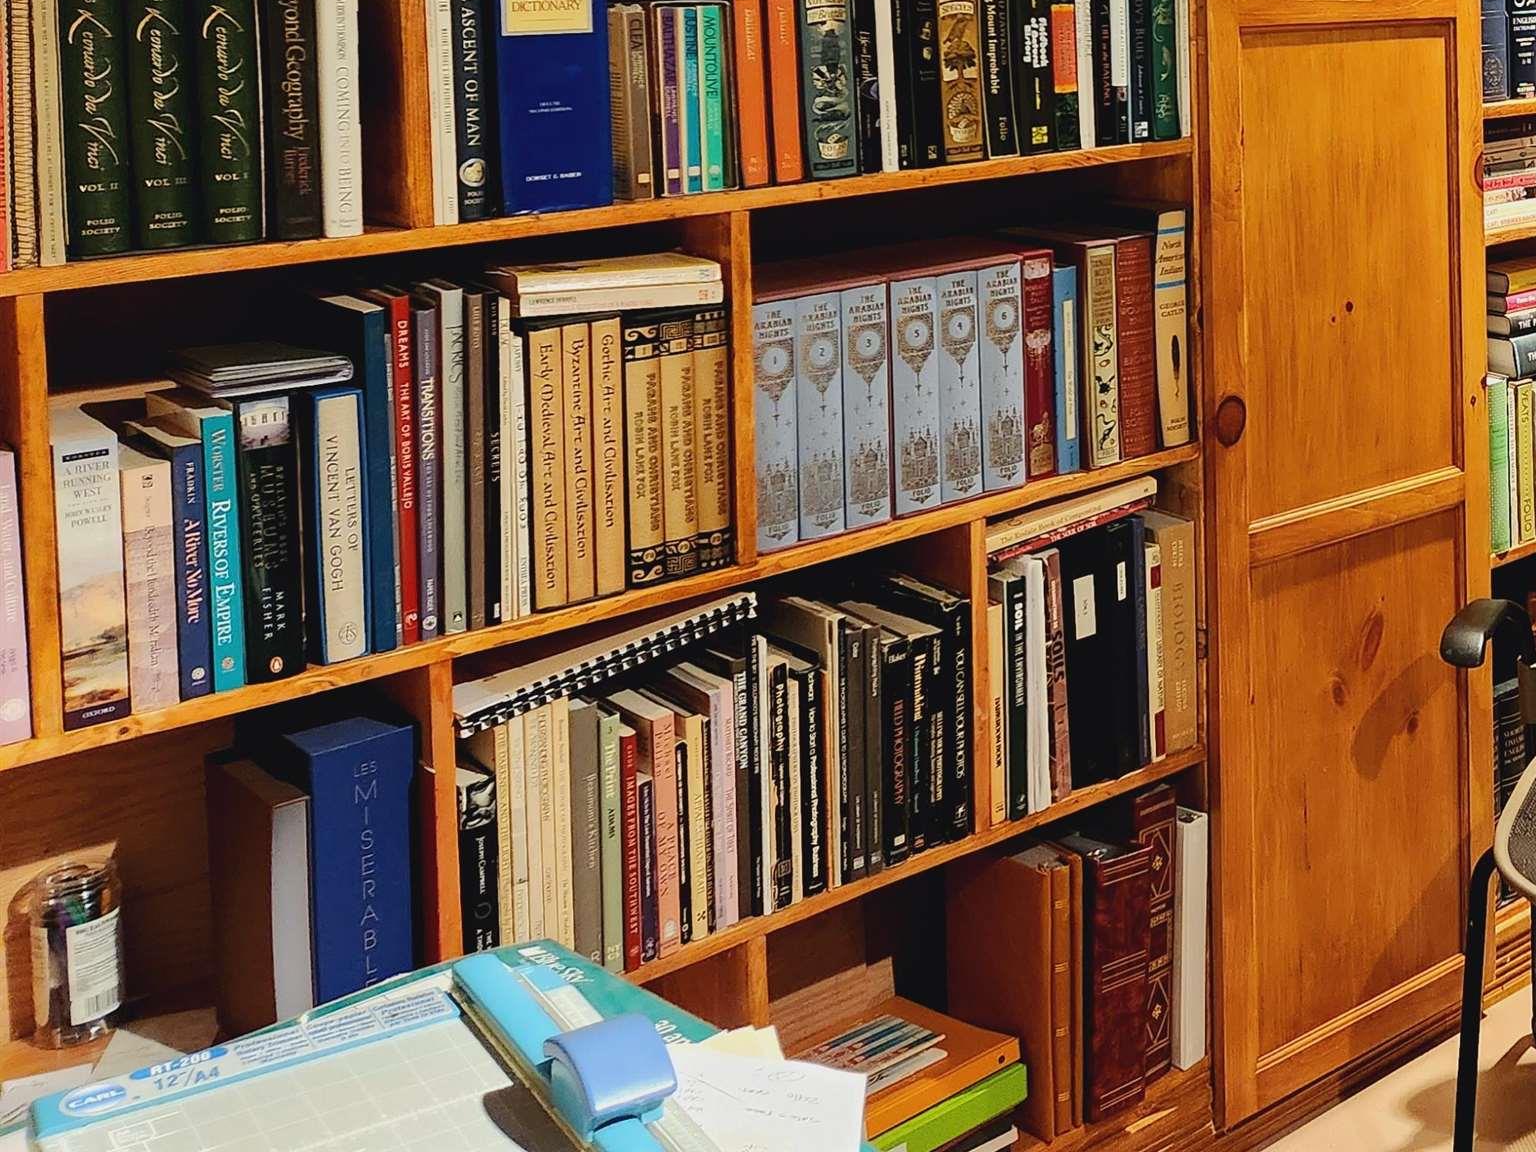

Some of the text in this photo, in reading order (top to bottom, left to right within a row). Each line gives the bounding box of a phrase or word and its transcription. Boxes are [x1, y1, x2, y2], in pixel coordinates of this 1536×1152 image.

[511, 0, 582, 13] DICTIONARY
[987, 5, 997, 36] Mount
[1512, 15, 1536, 25] ENGLISH
[461, 7, 478, 74] ASCENT
[628, 19, 643, 51] CLEA
[662, 16, 677, 87] BALTHAZAR
[684, 16, 698, 59] JUSTINE
[702, 16, 719, 97] MOUNTOLIVE
[988, 38, 1000, 95] Improbable
[281, 45, 309, 143] Geography
[336, 65, 351, 128] COMING
[464, 79, 480, 105] OF
[465, 107, 481, 147] MAN
[336, 167, 352, 214] BEING
[81, 227, 121, 236] SOCIETY
[86, 218, 116, 226] FOLIO
[149, 220, 189, 230] SOCIETY
[754, 318, 793, 331] ARABIAN
[802, 309, 838, 322] ARABIAN
[806, 320, 835, 333] NIGHTS
[848, 302, 885, 315] ARABIAN
[853, 312, 882, 323] NIGHTS
[1518, 320, 1532, 331] THE
[397, 320, 409, 369] DREAMS
[758, 328, 790, 340] NIGHTS
[401, 382, 410, 401] THE
[402, 402, 411, 422] ART
[402, 423, 412, 439] OF
[418, 377, 436, 461] TRANSITIONS
[600, 334, 617, 530] Gothic Art and Civilisation
[403, 440, 413, 469] BORIS
[539, 343, 558, 590] Early Medieval Art and Civilisation
[568, 339, 587, 560] Byzantine Art and Civilisation
[1520, 389, 1533, 533] YEATS FOLIO
[63, 473, 112, 489] RUNNING
[73, 486, 102, 500] WEST
[185, 462, 196, 504] FRADKIN
[403, 469, 414, 510] VALLEJO
[70, 515, 108, 529] POWELL
[325, 436, 344, 592] VINCENT VAN GOGH
[345, 467, 358, 552] LETTERS OF
[211, 429, 236, 647] WORSTER RIVERS OF EMPIRE
[261, 587, 273, 642] FISHER
[275, 591, 285, 631] MARK
[1171, 580, 1186, 674] BIOLOGY
[1052, 629, 1065, 685] SOILS
[82, 705, 116, 720] OXFORD
[736, 671, 750, 770] THE GRAND CANYON
[775, 682, 786, 752] Photography
[353, 759, 378, 778] LES
[67, 1086, 125, 1111] CARL
